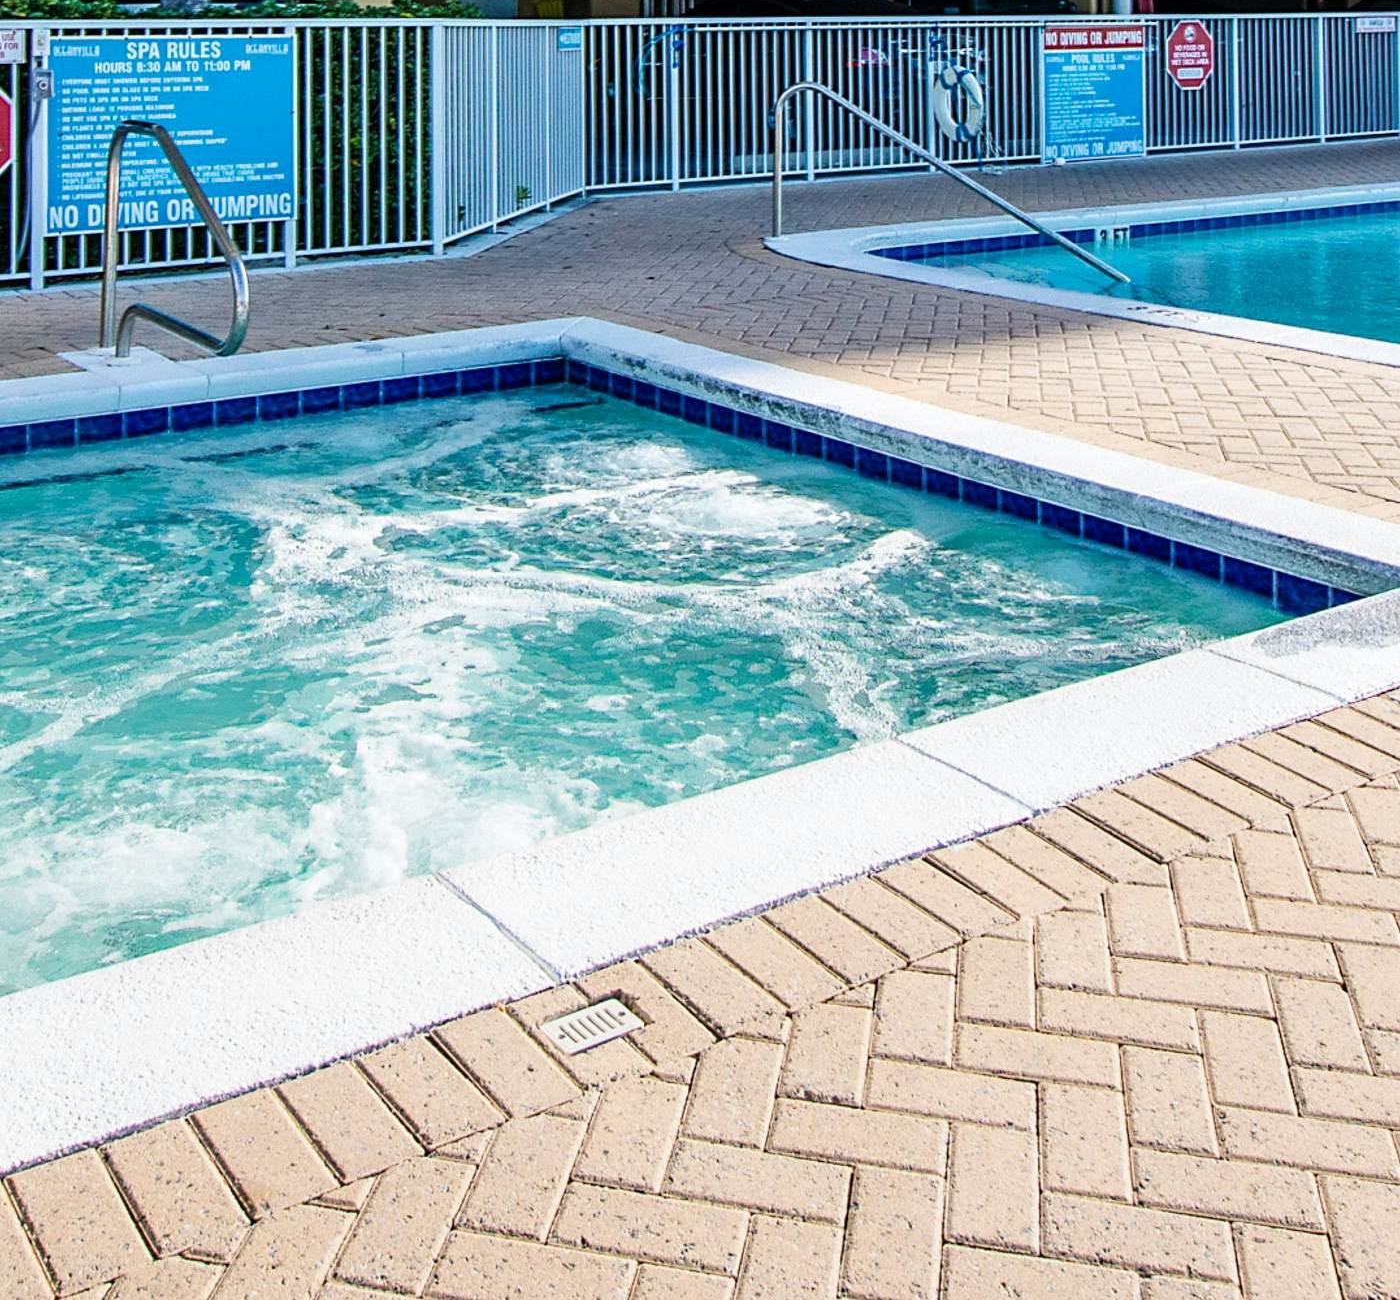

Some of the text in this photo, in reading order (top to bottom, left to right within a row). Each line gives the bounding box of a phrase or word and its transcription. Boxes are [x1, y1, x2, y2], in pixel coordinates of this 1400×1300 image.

[1046, 30, 1142, 46] NO DIVING OR JUMPING
[127, 41, 221, 59] SPA RULES
[1072, 54, 1090, 63] POOL
[1092, 53, 1115, 63] RULES
[94, 60, 250, 73] HOURS 8:30 AM TO 11:00 PM
[1046, 140, 1142, 157] NO DIVING OR JUMPING
[49, 205, 78, 229] NO
[167, 199, 195, 221] OR
[1113, 228, 1128, 241] FT
